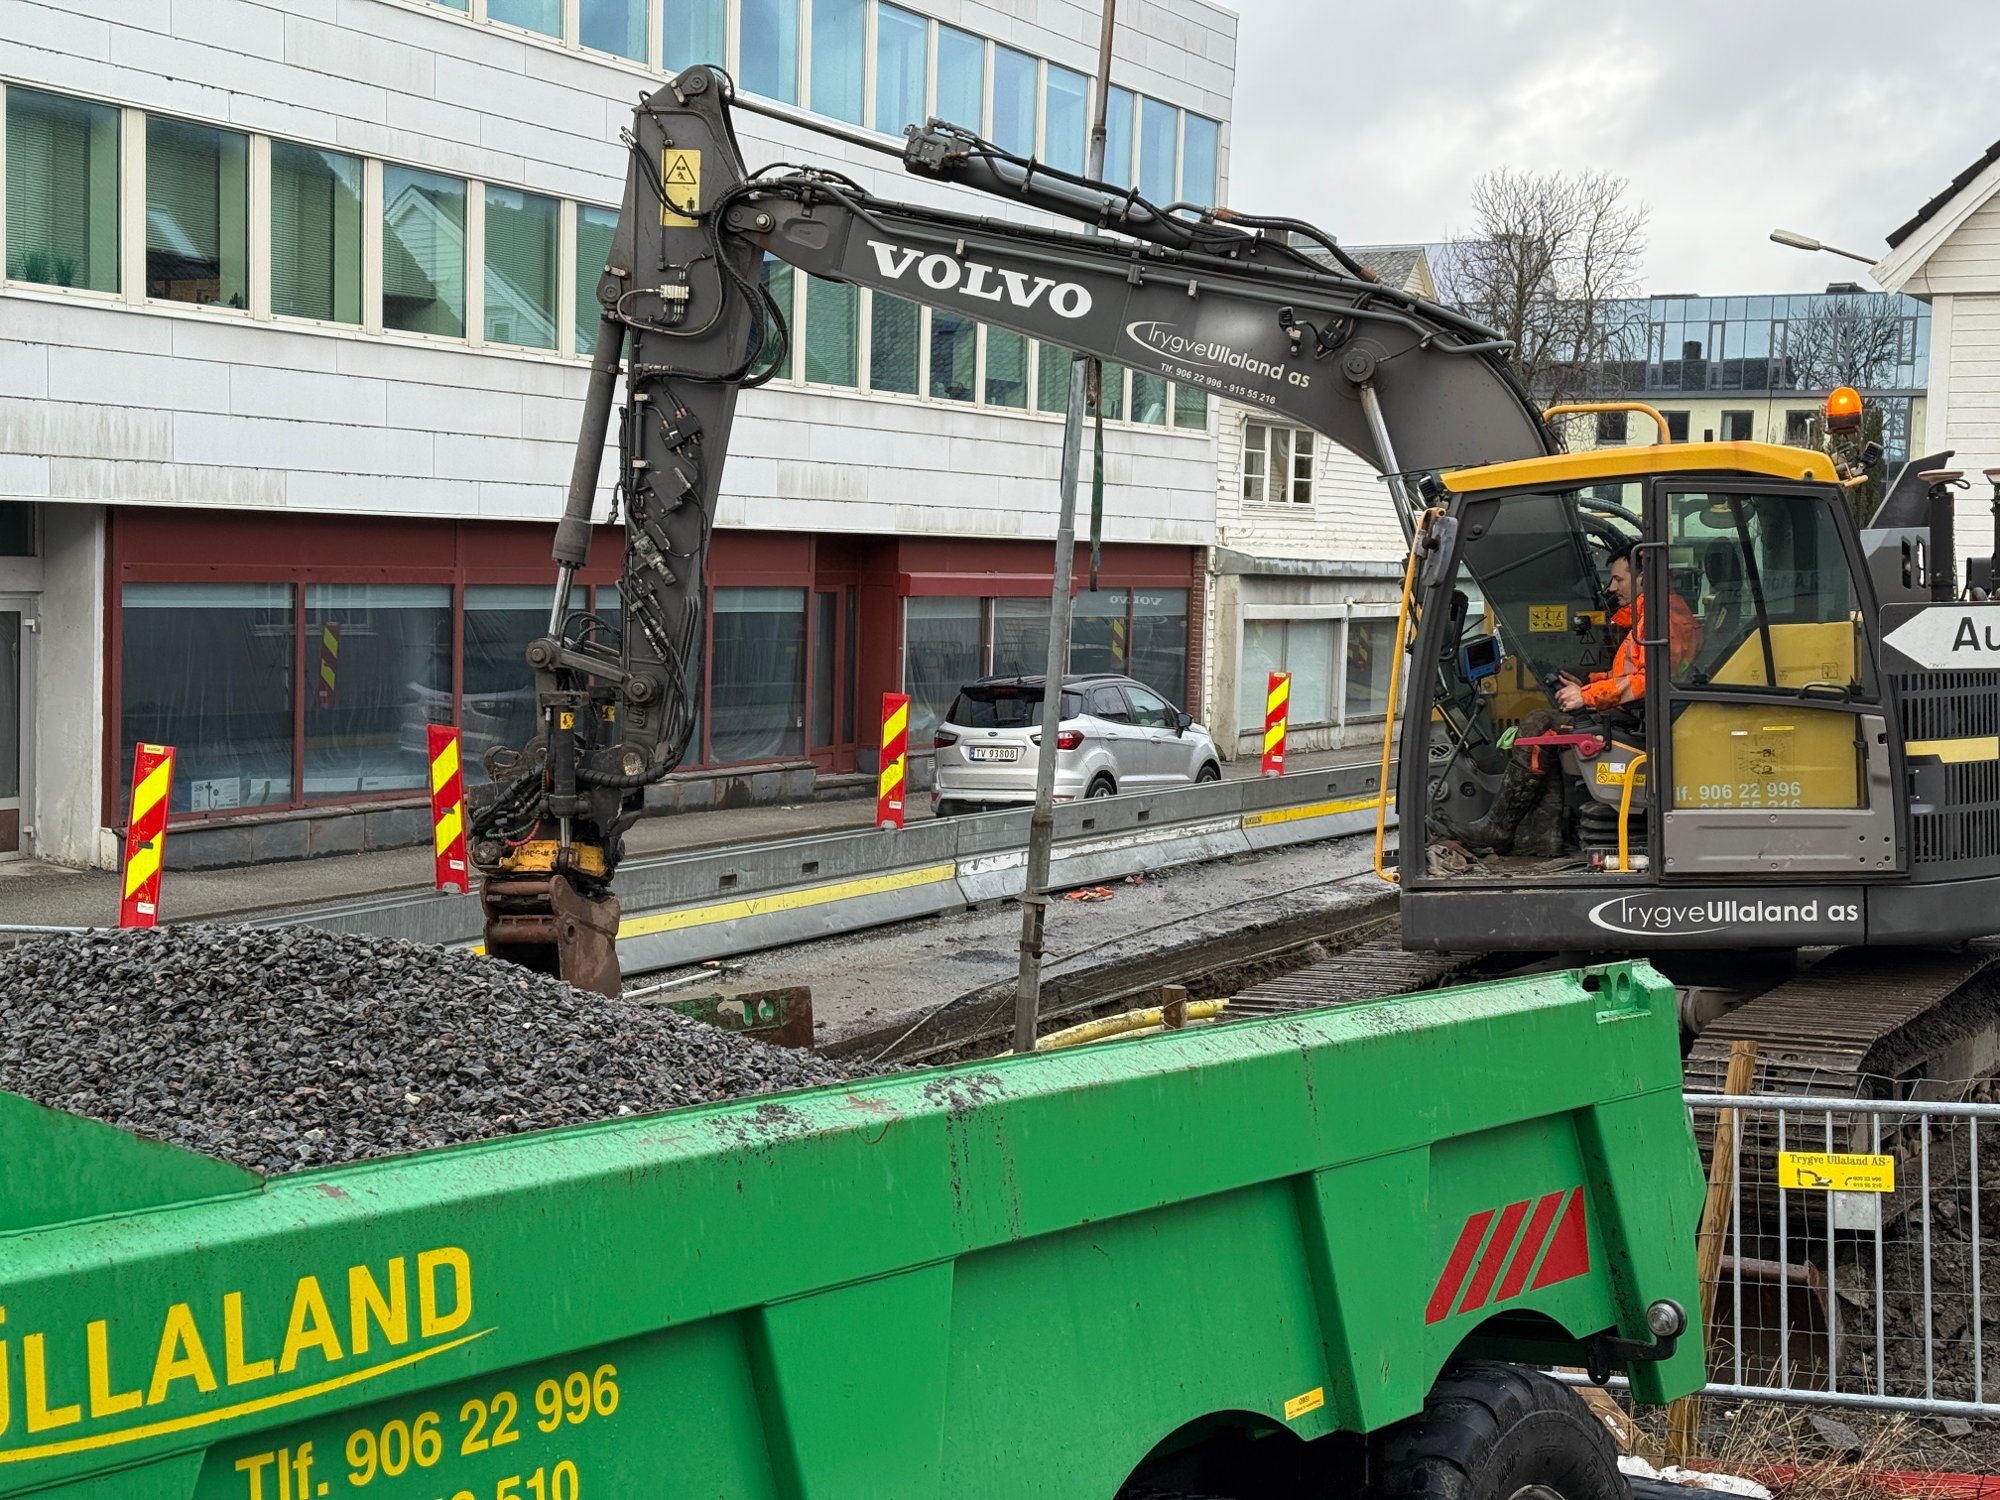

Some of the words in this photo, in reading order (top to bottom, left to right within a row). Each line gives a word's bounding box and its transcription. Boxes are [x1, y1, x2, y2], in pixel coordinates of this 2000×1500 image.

[867, 240, 1092, 318] VOLVO
[1176, 367, 1192, 380] 906
[1193, 372, 1205, 384] 22
[1206, 376, 1222, 388] 996
[1229, 384, 1246, 396] 915
[1246, 388, 1259, 399] 55
[1259, 392, 1276, 404] 216
[1288, 371, 1311, 388] as
[976, 749, 987, 758] TV
[989, 749, 1015, 758] 93808
[1672, 785, 1692, 801] lf.
[1699, 784, 1732, 800] 906
[1739, 783, 1761, 799] 22
[1767, 781, 1801, 798] 996
[1828, 904, 1858, 921] as
[1790, 1154, 1824, 1165] Trygve
[1827, 1156, 1868, 1165] Ullaland
[1871, 1157, 1886, 1166] AS
[0, 1246, 473, 1438] LLALAND
[235, 1441, 328, 1500] Tlf.
[346, 1428, 442, 1487] 906
[459, 1391, 519, 1456] 22
[535, 1364, 619, 1433] 996
